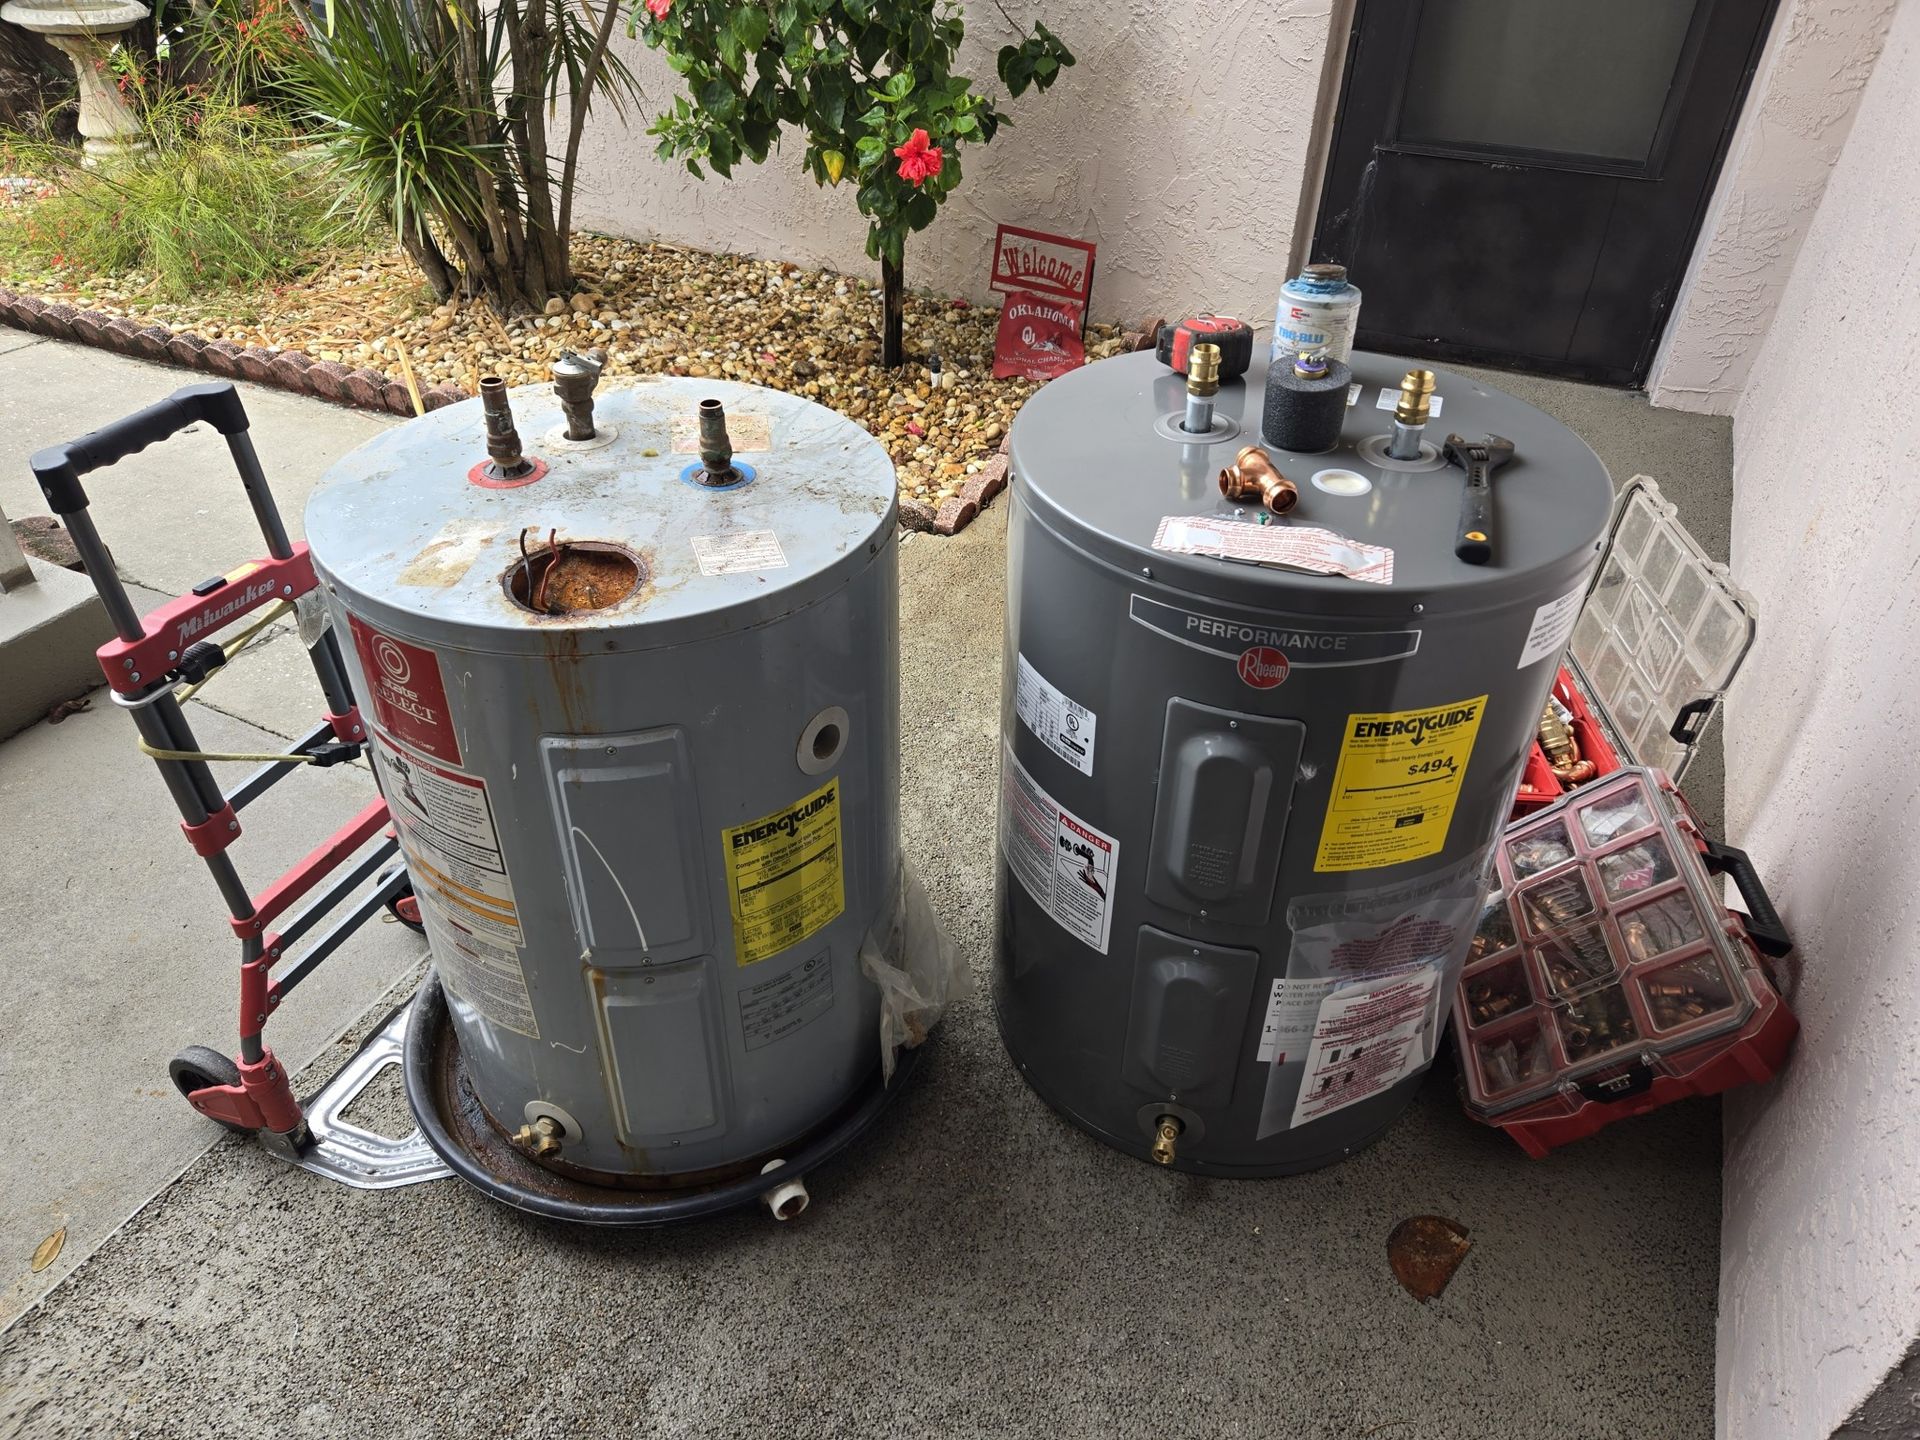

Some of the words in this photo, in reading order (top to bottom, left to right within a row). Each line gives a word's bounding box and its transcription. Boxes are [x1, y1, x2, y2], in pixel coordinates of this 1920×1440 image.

[1003, 246, 1082, 288] Welcome
[1009, 304, 1075, 331] OKLAHOMA
[177, 579, 275, 647] Milwaukee
[1186, 616, 1347, 650] PERFORMANCE
[1243, 648, 1287, 681] Rheem
[376, 683, 436, 720] SELECT
[381, 676, 419, 701] state
[1354, 706, 1477, 738] ENERGYGUIDE
[1407, 756, 1453, 776] $494
[732, 787, 835, 849] ENERGYGUIDE
[1070, 822, 1108, 850] DANGER
[1369, 983, 1408, 1000] IMPORTANT
